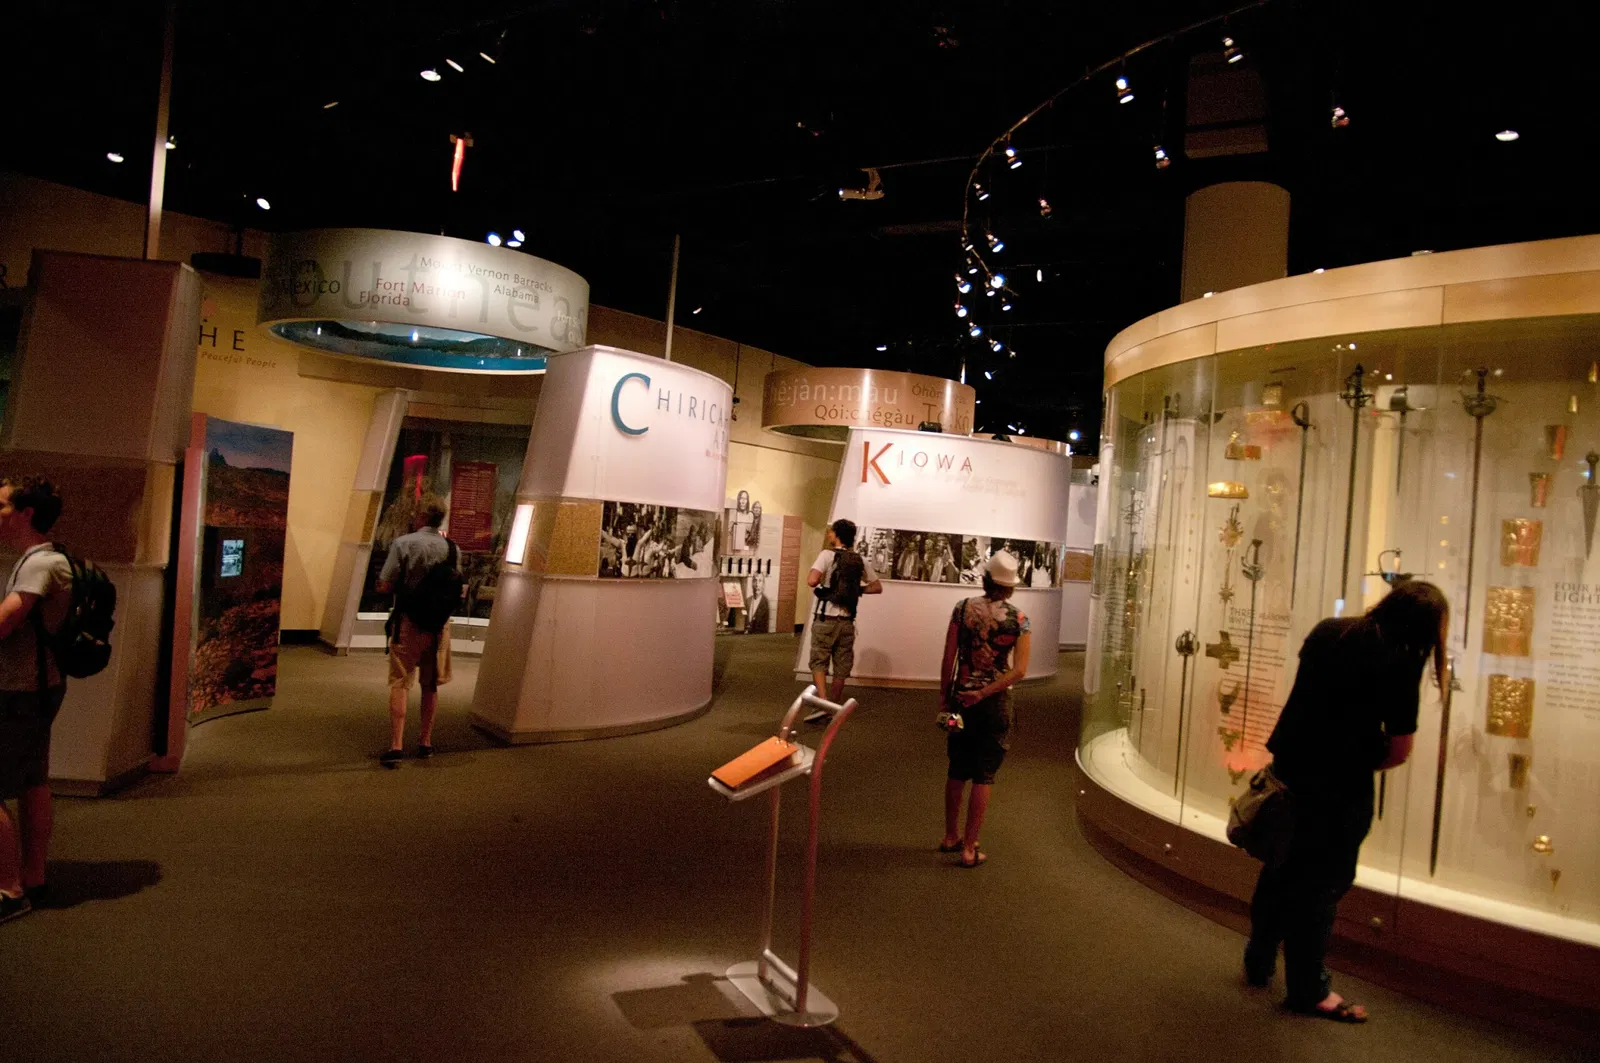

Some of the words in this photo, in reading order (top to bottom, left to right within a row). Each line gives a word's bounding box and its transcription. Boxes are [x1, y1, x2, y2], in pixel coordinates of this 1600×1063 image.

[375, 278, 405, 292] Fort
[468, 264, 510, 281] Vernon
[513, 273, 553, 293] Barracks
[360, 291, 410, 307] Florida
[493, 284, 539, 304] Alabama
[201, 351, 243, 364] Peaceful
[246, 357, 277, 368] People
[861, 441, 974, 485] KIOWA
